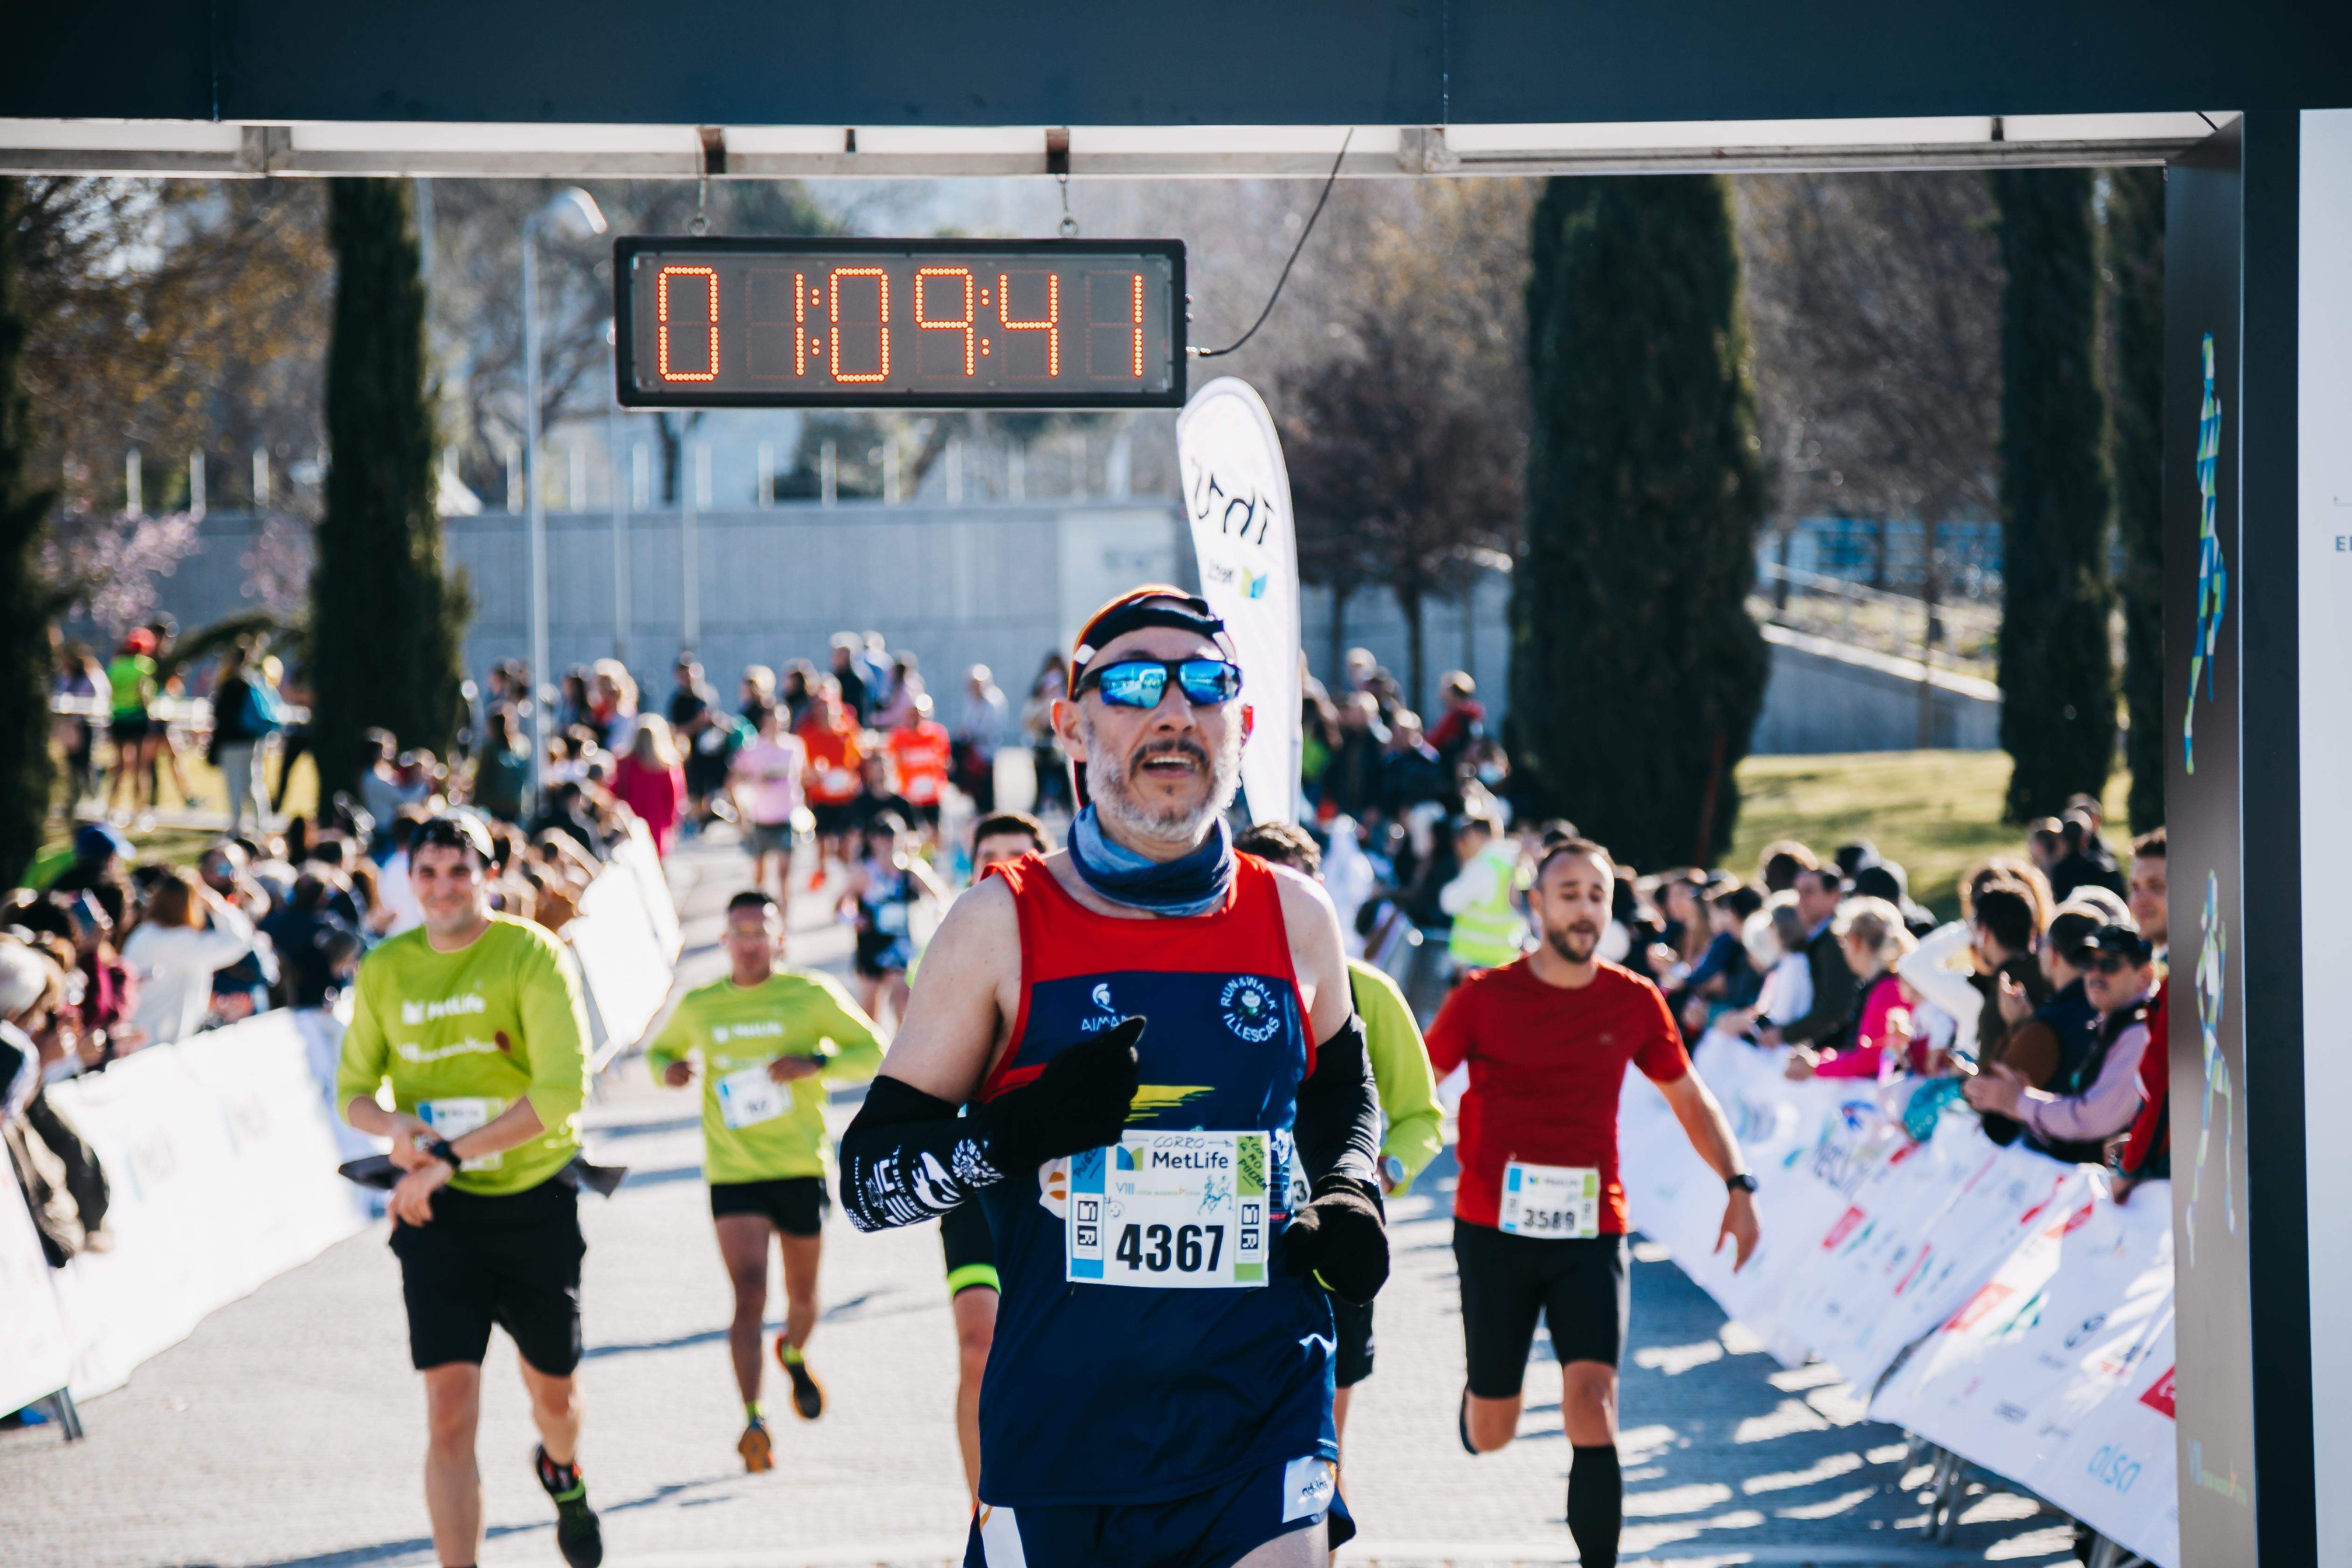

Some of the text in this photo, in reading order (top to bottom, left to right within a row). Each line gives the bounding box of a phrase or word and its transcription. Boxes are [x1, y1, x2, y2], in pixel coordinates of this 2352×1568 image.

[1223, 1013, 1280, 1043] ILLESCAS
[1152, 1151, 1228, 1169] MetLife
[1115, 1183, 1134, 1195] VIII
[1116, 1223, 1225, 1272] 4367
